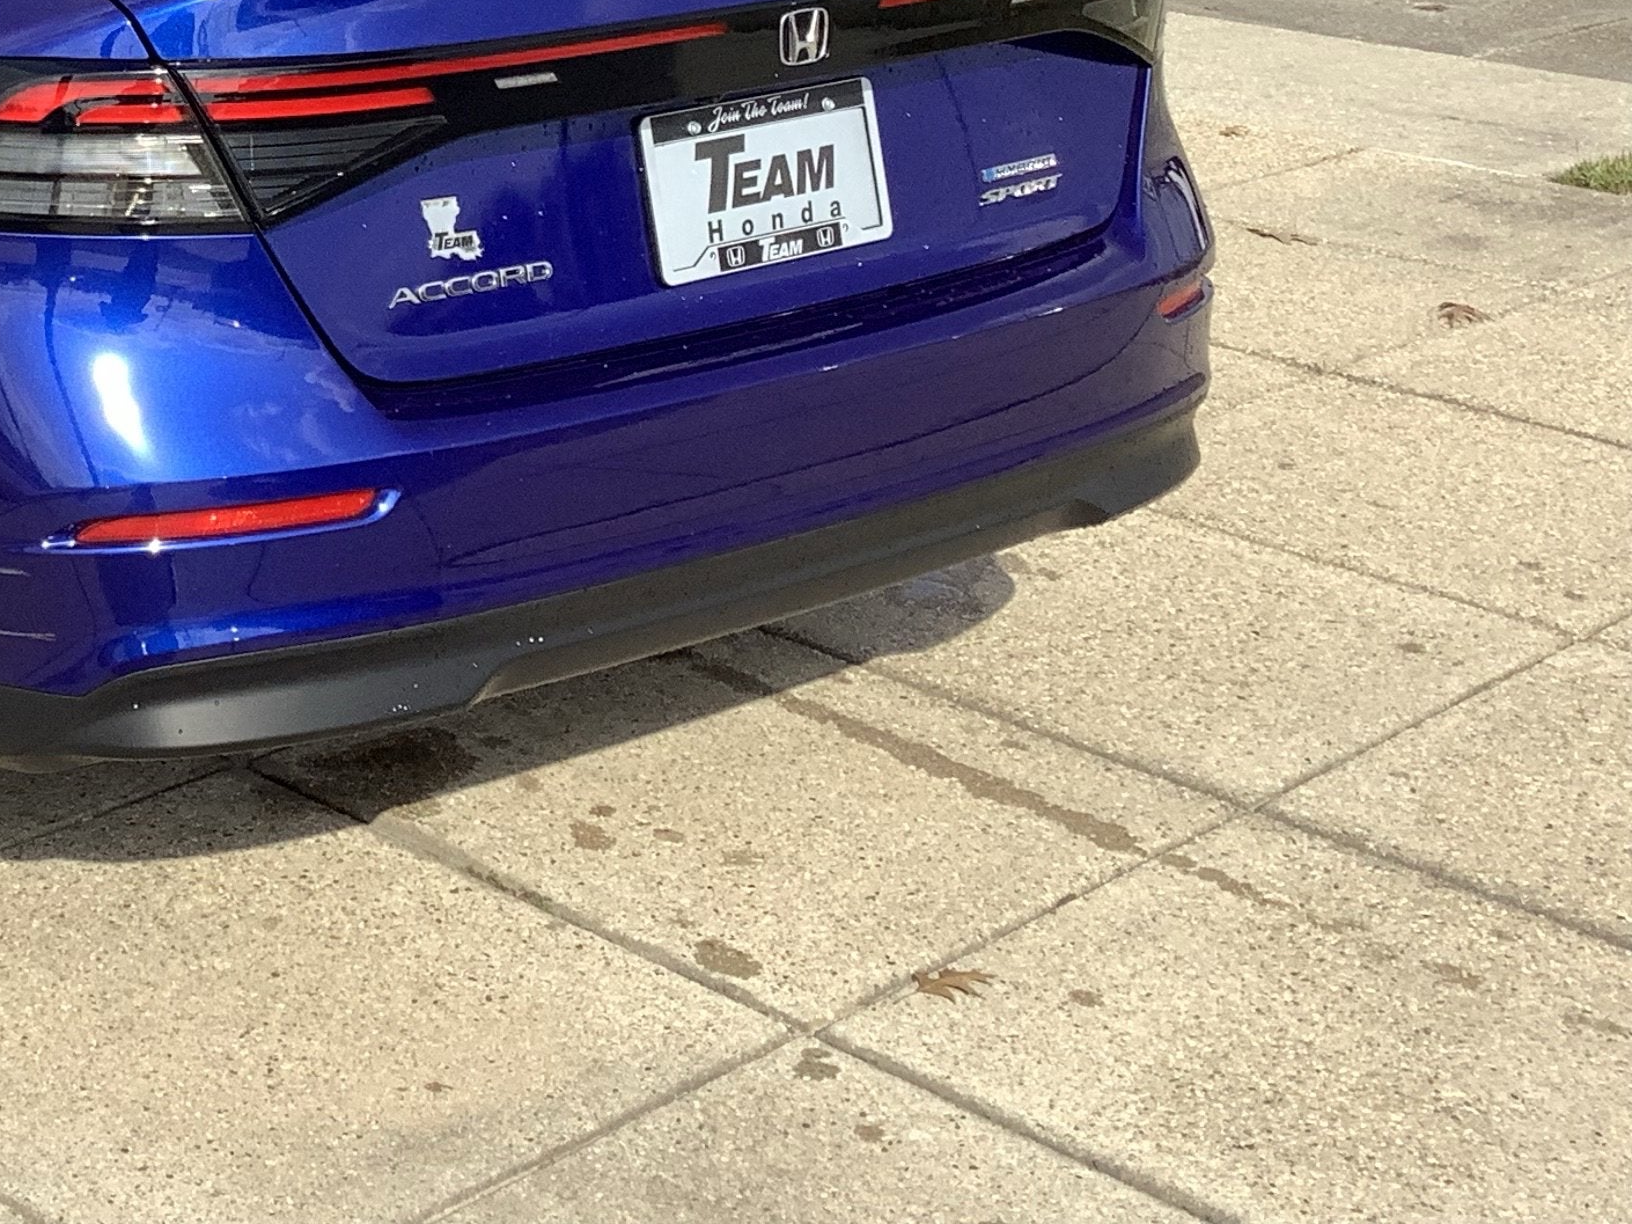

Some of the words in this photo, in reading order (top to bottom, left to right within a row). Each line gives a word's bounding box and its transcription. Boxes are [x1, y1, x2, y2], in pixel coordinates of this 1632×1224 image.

[708, 106, 741, 132] Join
[741, 101, 767, 120] The
[767, 93, 809, 116] Team!
[695, 133, 834, 214] TEAM
[435, 232, 473, 251] TEAM
[708, 200, 842, 243] Honda
[759, 237, 803, 262] TEAM
[388, 261, 554, 309] ACCORD
